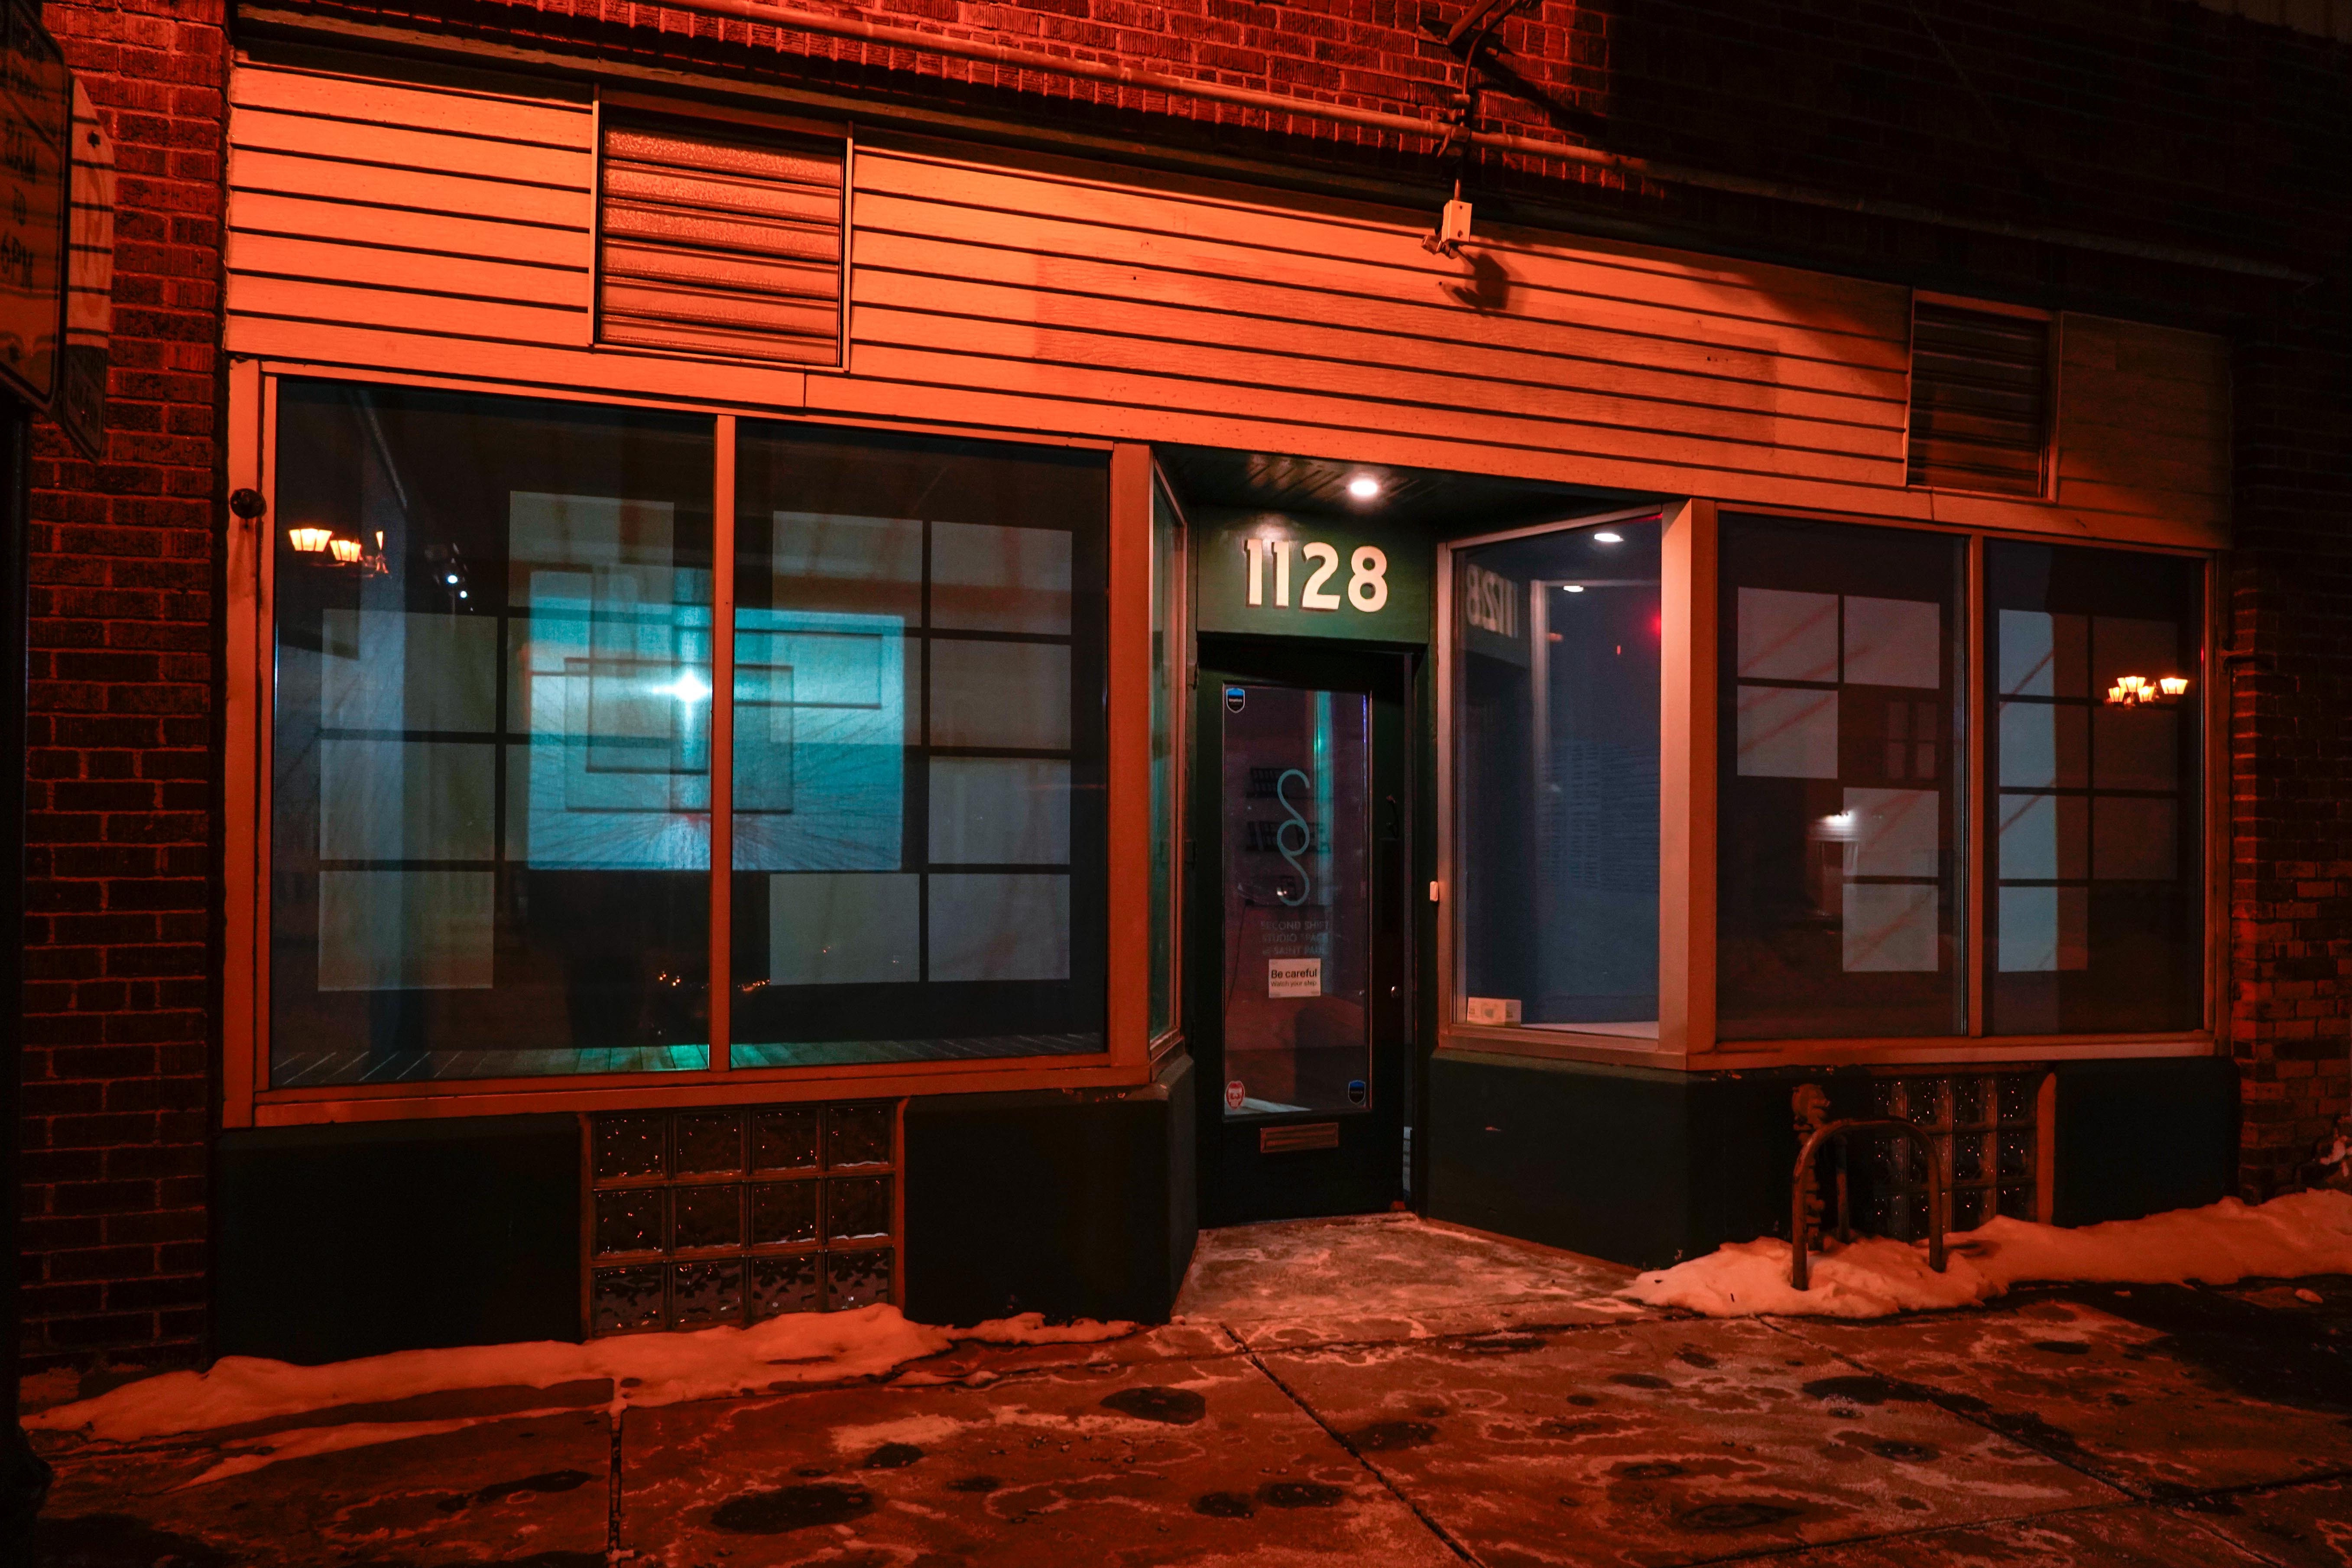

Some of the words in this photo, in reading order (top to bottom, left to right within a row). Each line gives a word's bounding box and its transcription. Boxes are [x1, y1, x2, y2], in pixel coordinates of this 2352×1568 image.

[1245, 539, 1388, 613] 1128
[1261, 921, 1301, 931] SECOND
[1272, 970, 1283, 978] Be
[1285, 968, 1317, 978] careful
